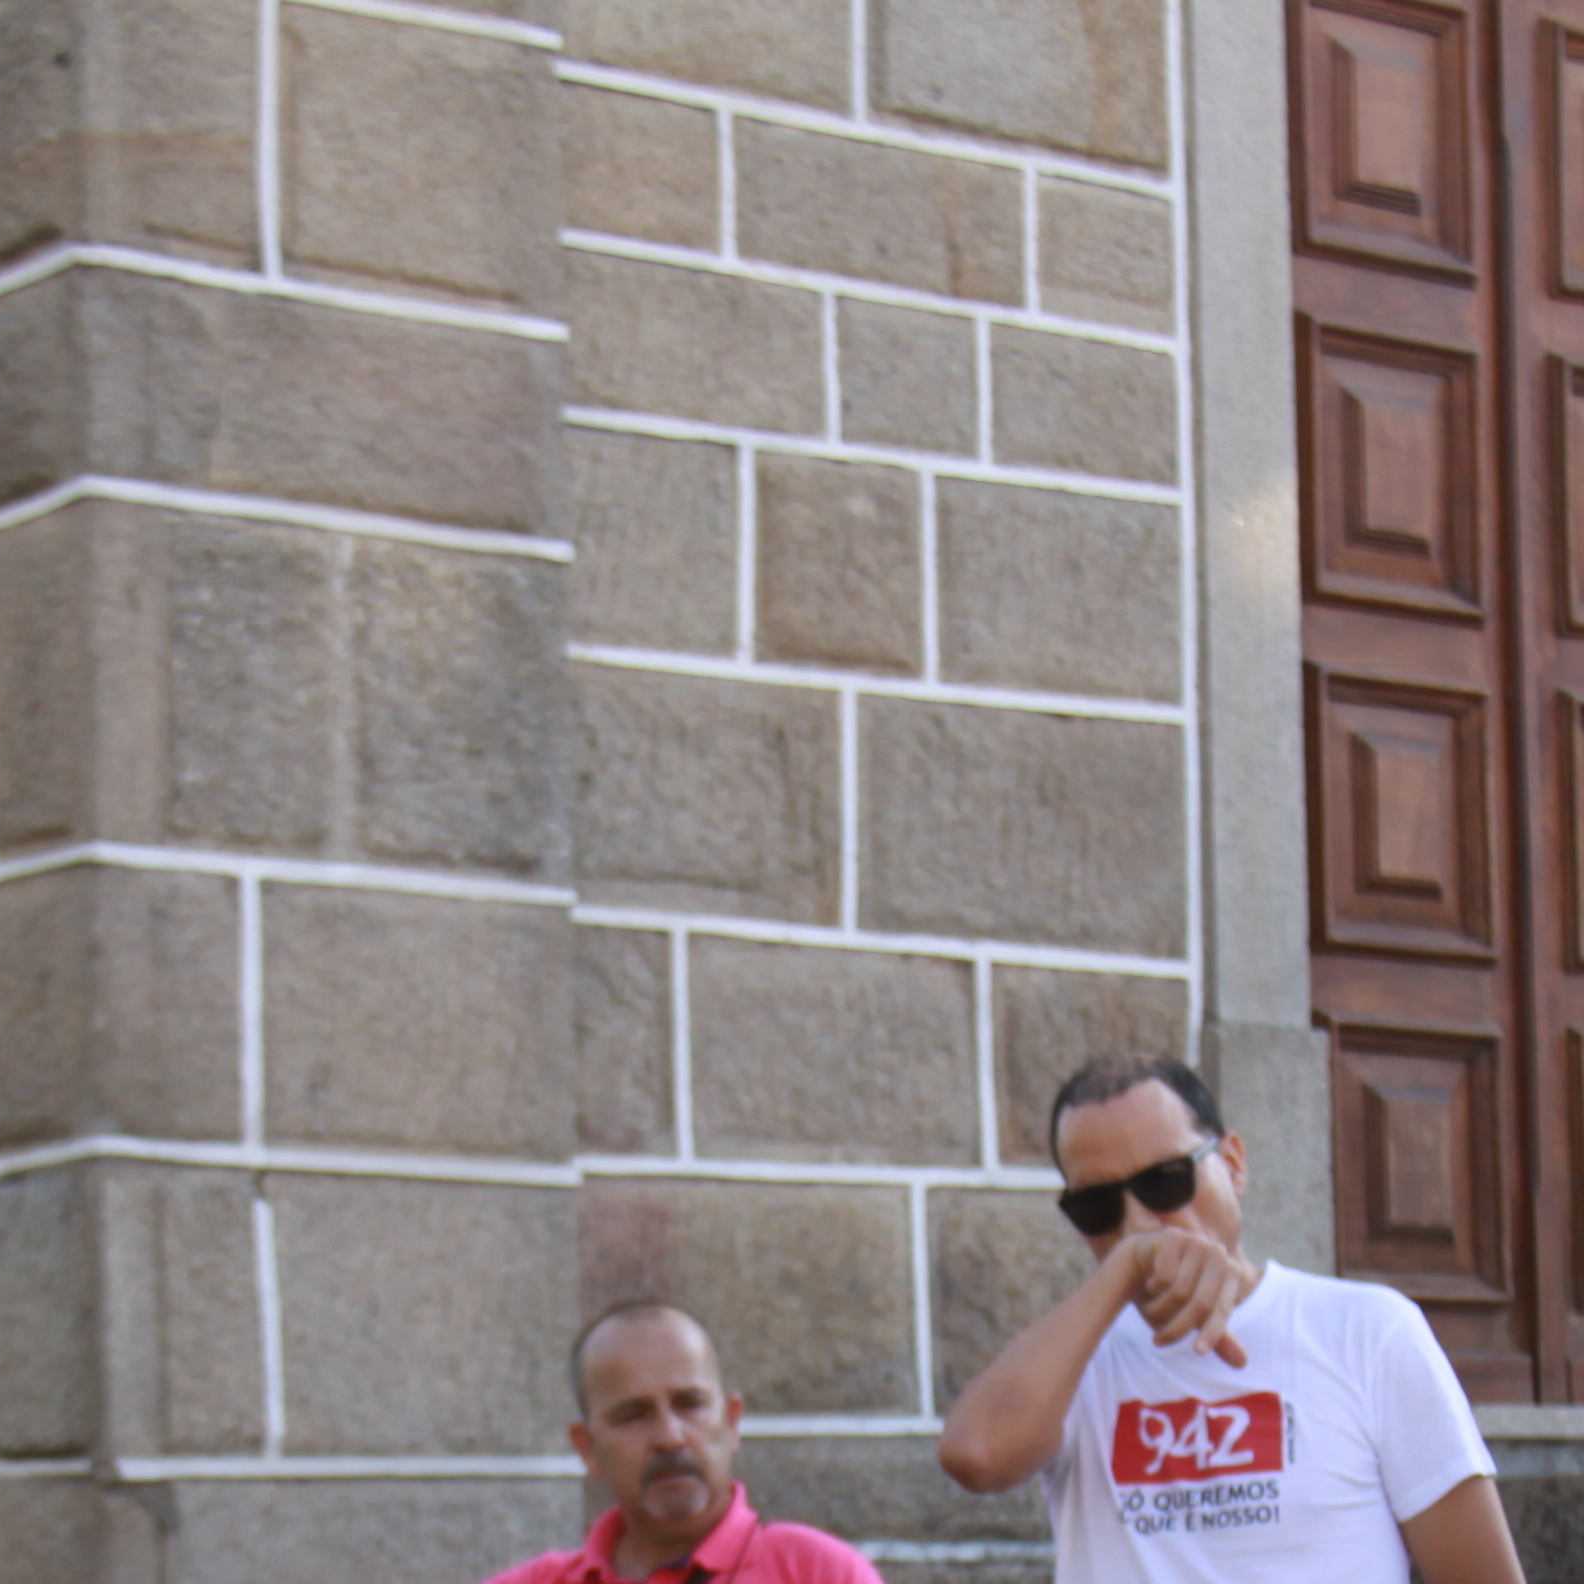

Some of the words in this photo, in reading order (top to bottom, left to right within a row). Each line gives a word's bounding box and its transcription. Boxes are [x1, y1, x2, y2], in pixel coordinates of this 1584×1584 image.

[1154, 1480, 1280, 1512] QUEREMOS
[1134, 1513, 1178, 1536] QUE
[1201, 1504, 1280, 1529] NOSSO!
